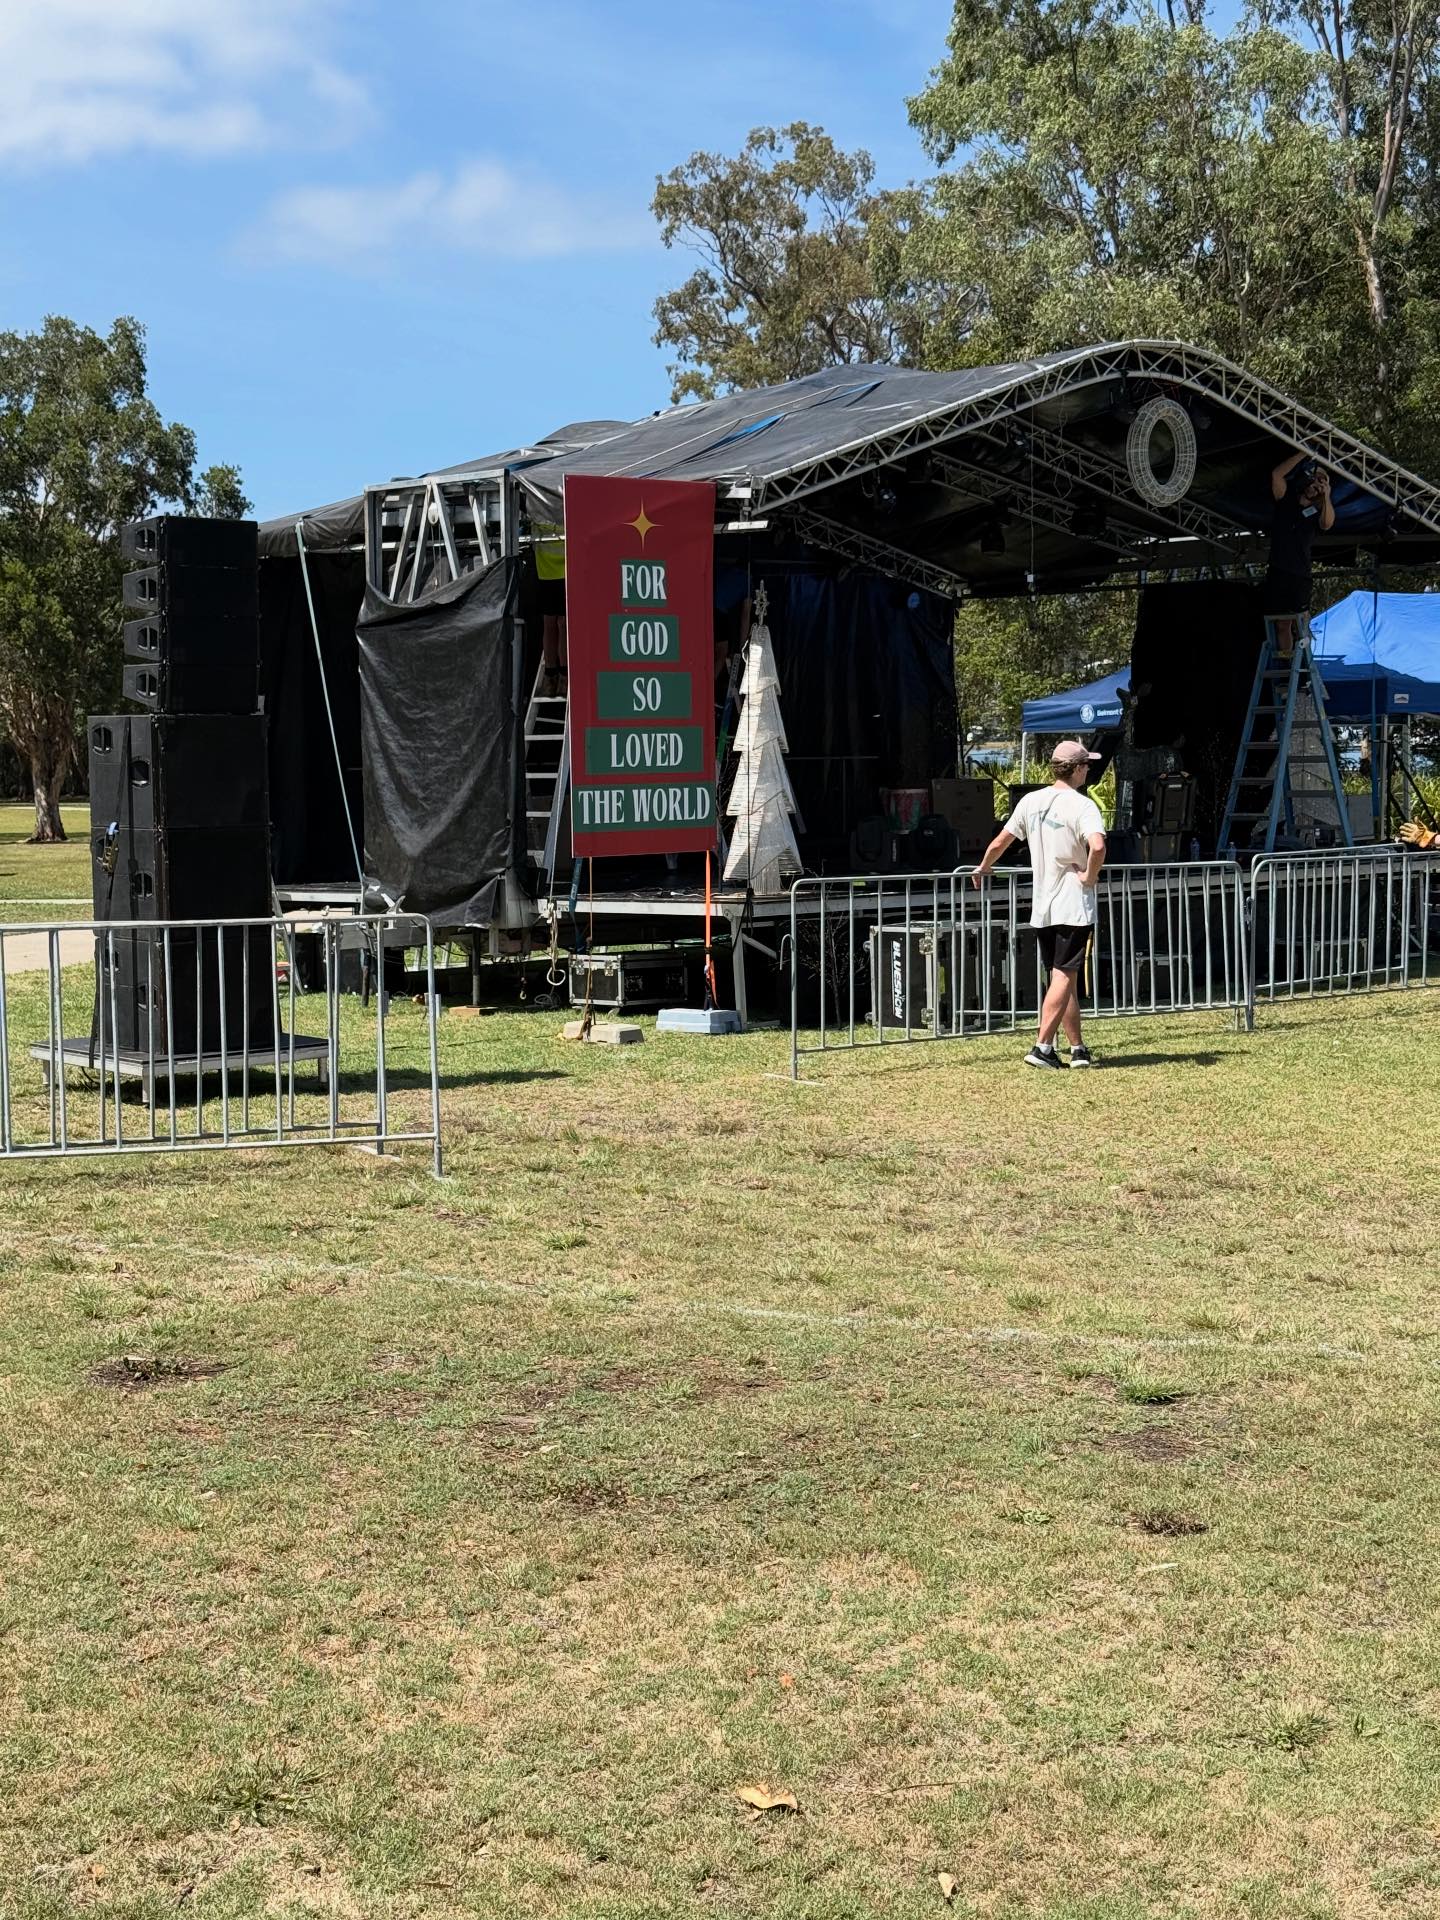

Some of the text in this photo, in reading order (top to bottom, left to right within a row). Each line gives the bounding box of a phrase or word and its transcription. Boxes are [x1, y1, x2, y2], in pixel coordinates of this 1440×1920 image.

[621, 564, 667, 600] FOR
[621, 620, 669, 656] GOD
[632, 677, 662, 712] SO
[610, 733, 684, 768] LOVED
[578, 786, 710, 825] THE WORLD
[892, 940, 903, 1019] BLUESHOW
